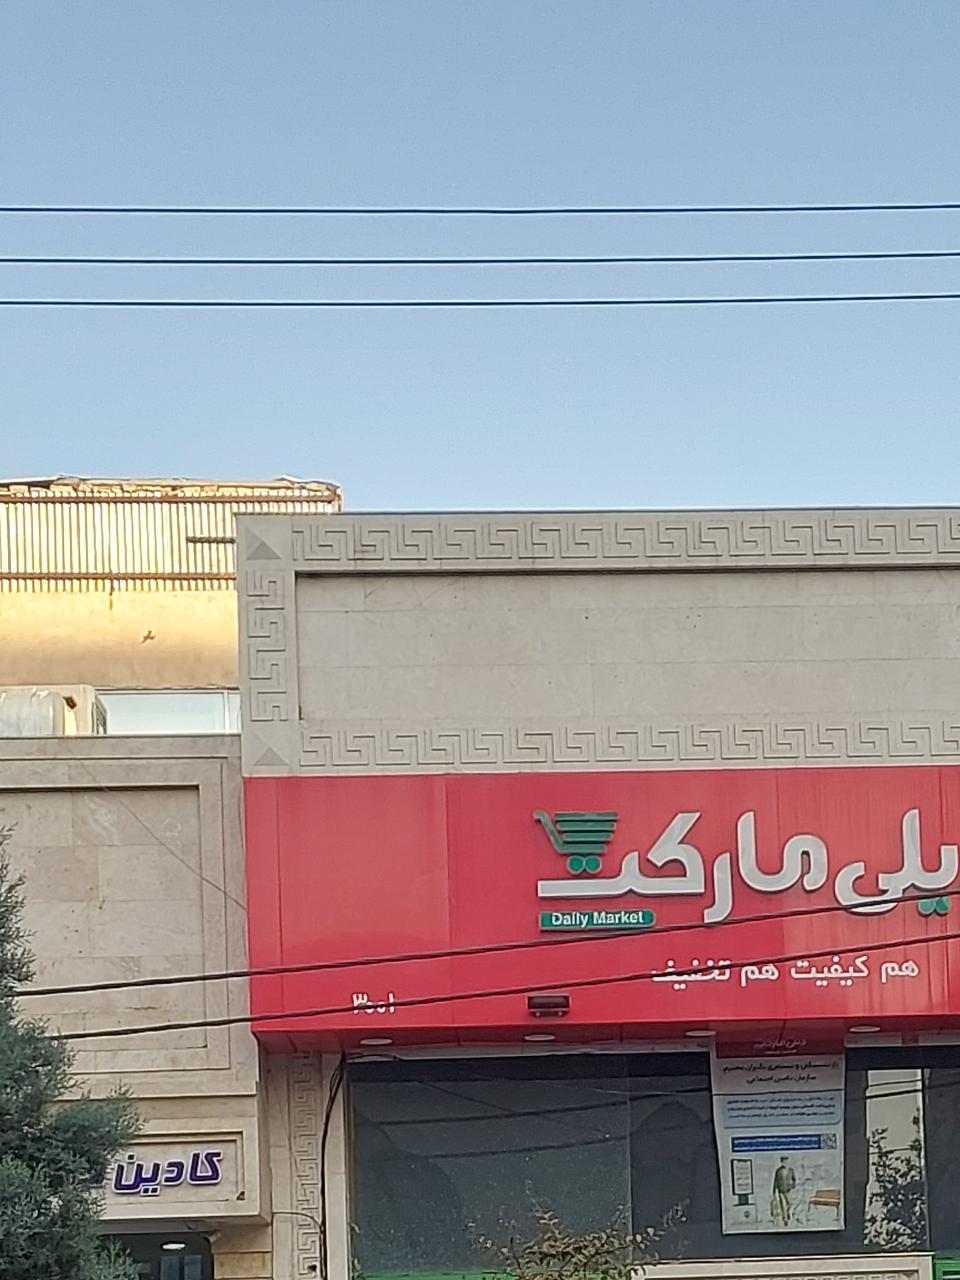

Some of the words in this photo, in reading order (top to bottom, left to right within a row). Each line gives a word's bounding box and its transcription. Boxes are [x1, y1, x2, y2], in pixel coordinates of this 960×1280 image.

[537, 810, 829, 924] مارکت
[551, 912, 590, 929] Daily
[592, 911, 645, 927] Market
[741, 963, 779, 987] هم
[790, 955, 869, 987] کیفیت
[880, 959, 919, 984] هم
[113, 1149, 223, 1195] کادین
